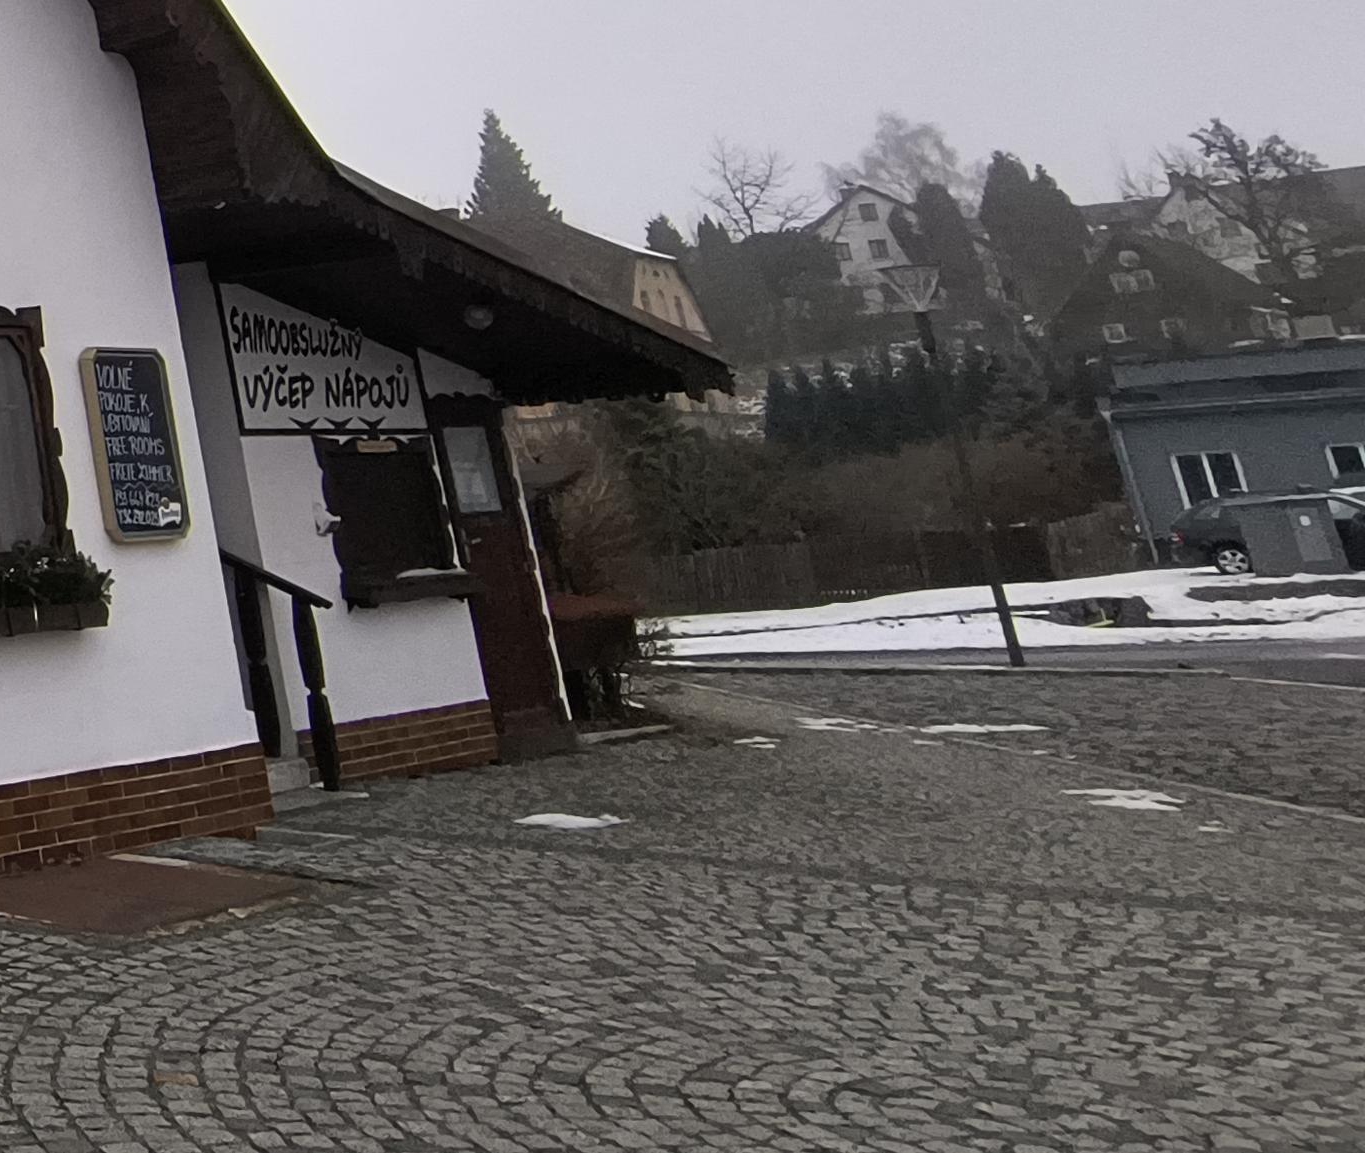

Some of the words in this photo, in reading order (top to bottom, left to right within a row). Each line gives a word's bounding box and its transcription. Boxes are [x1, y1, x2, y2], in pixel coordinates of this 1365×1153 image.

[229, 304, 363, 361] SAMOOBSLUŽNÝ
[95, 360, 134, 391] VOLNÉ
[243, 363, 315, 412] VÝČEP
[325, 363, 410, 409] NÁPOJŮ
[105, 436, 129, 457] FREE
[128, 435, 166, 456] ROOMS
